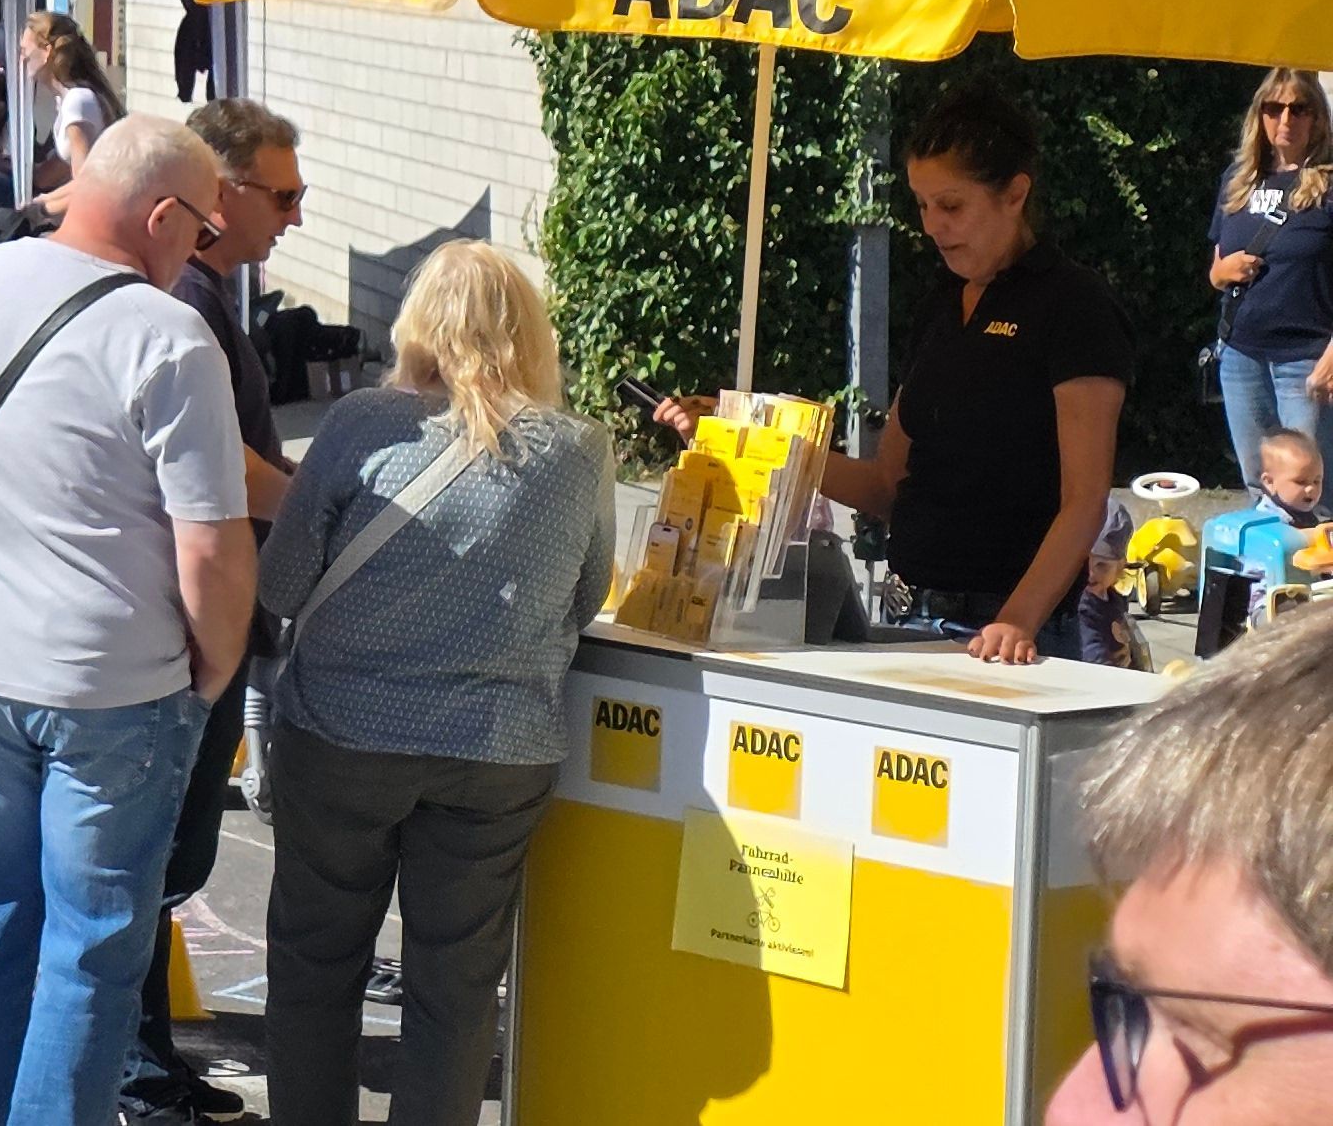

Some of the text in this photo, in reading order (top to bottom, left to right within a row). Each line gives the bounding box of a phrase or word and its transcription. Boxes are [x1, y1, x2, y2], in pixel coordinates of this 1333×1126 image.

[983, 321, 1019, 337] ADAC
[596, 700, 661, 738] ADAC
[732, 725, 801, 763] ADAC
[876, 750, 949, 789] ADAC
[741, 843, 794, 865] Fahrrad-
